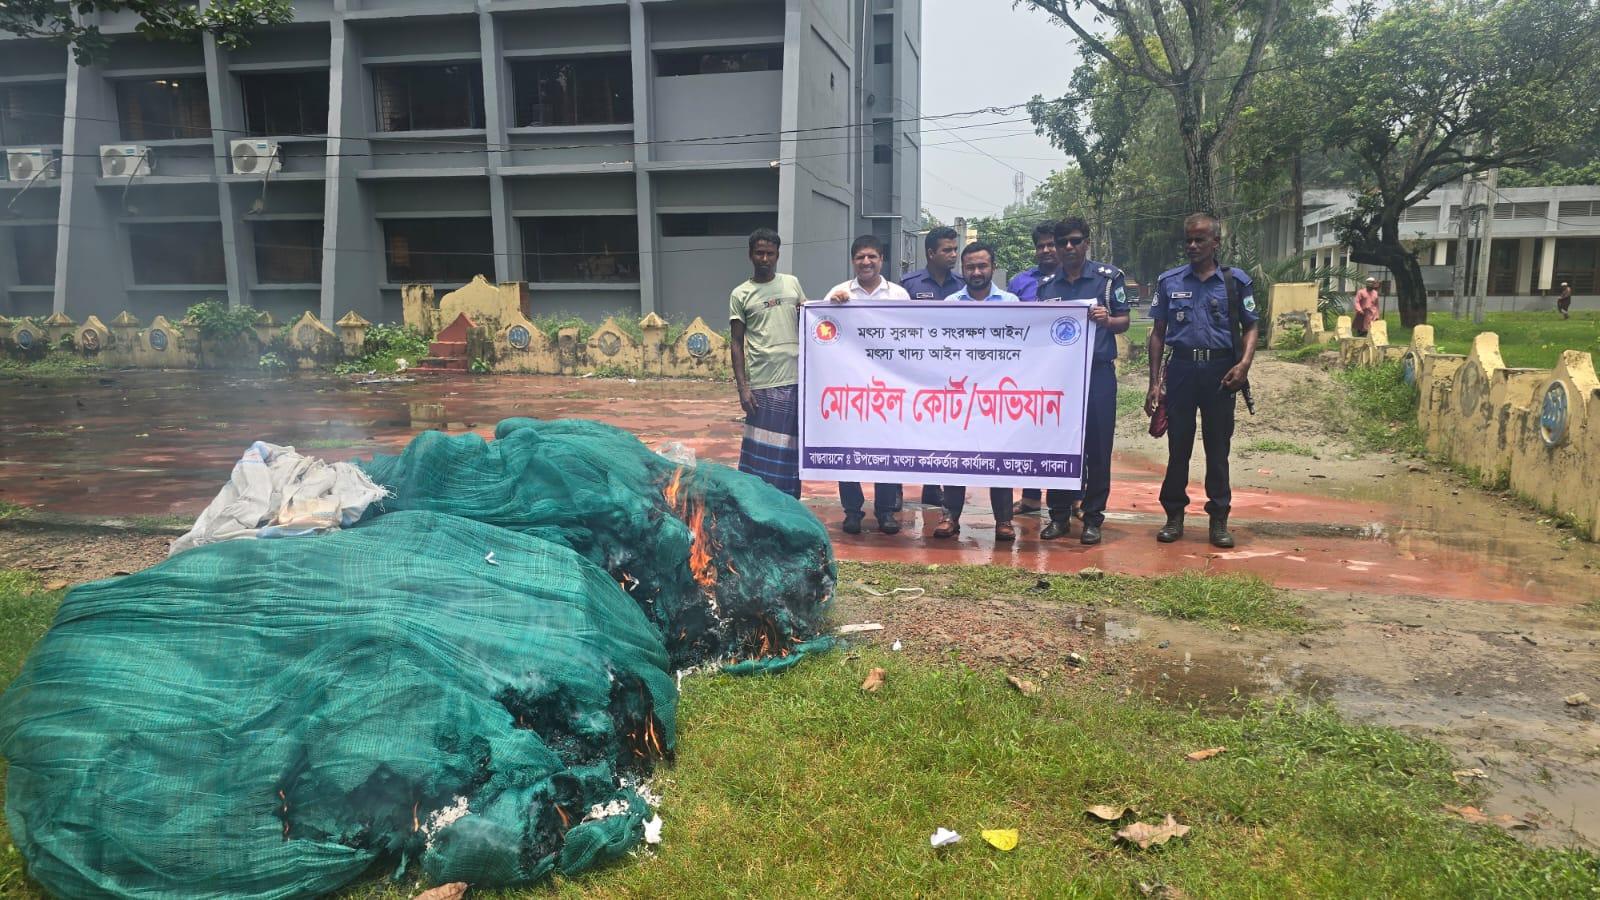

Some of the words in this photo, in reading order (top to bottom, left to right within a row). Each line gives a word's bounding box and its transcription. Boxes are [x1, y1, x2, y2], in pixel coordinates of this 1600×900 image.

[857, 327, 886, 339] মৎস্য
[890, 327, 923, 342] সুরক্ষা
[928, 328, 938, 338] ও
[942, 327, 986, 340] সংরক্ষণ
[989, 325, 1031, 342] আইন/
[865, 348, 894, 361] মৎস্য
[898, 348, 925, 361] খাদ্য
[928, 345, 962, 361] আইন
[965, 348, 1022, 361] বাস্তবায়নে
[820, 375, 906, 423] মোবাইল
[809, 452, 845, 465] বাস্তবায়নে
[853, 450, 890, 467] উপজেলা
[893, 454, 915, 467] মৎস্য
[918, 452, 959, 469] কর্মকর্তার
